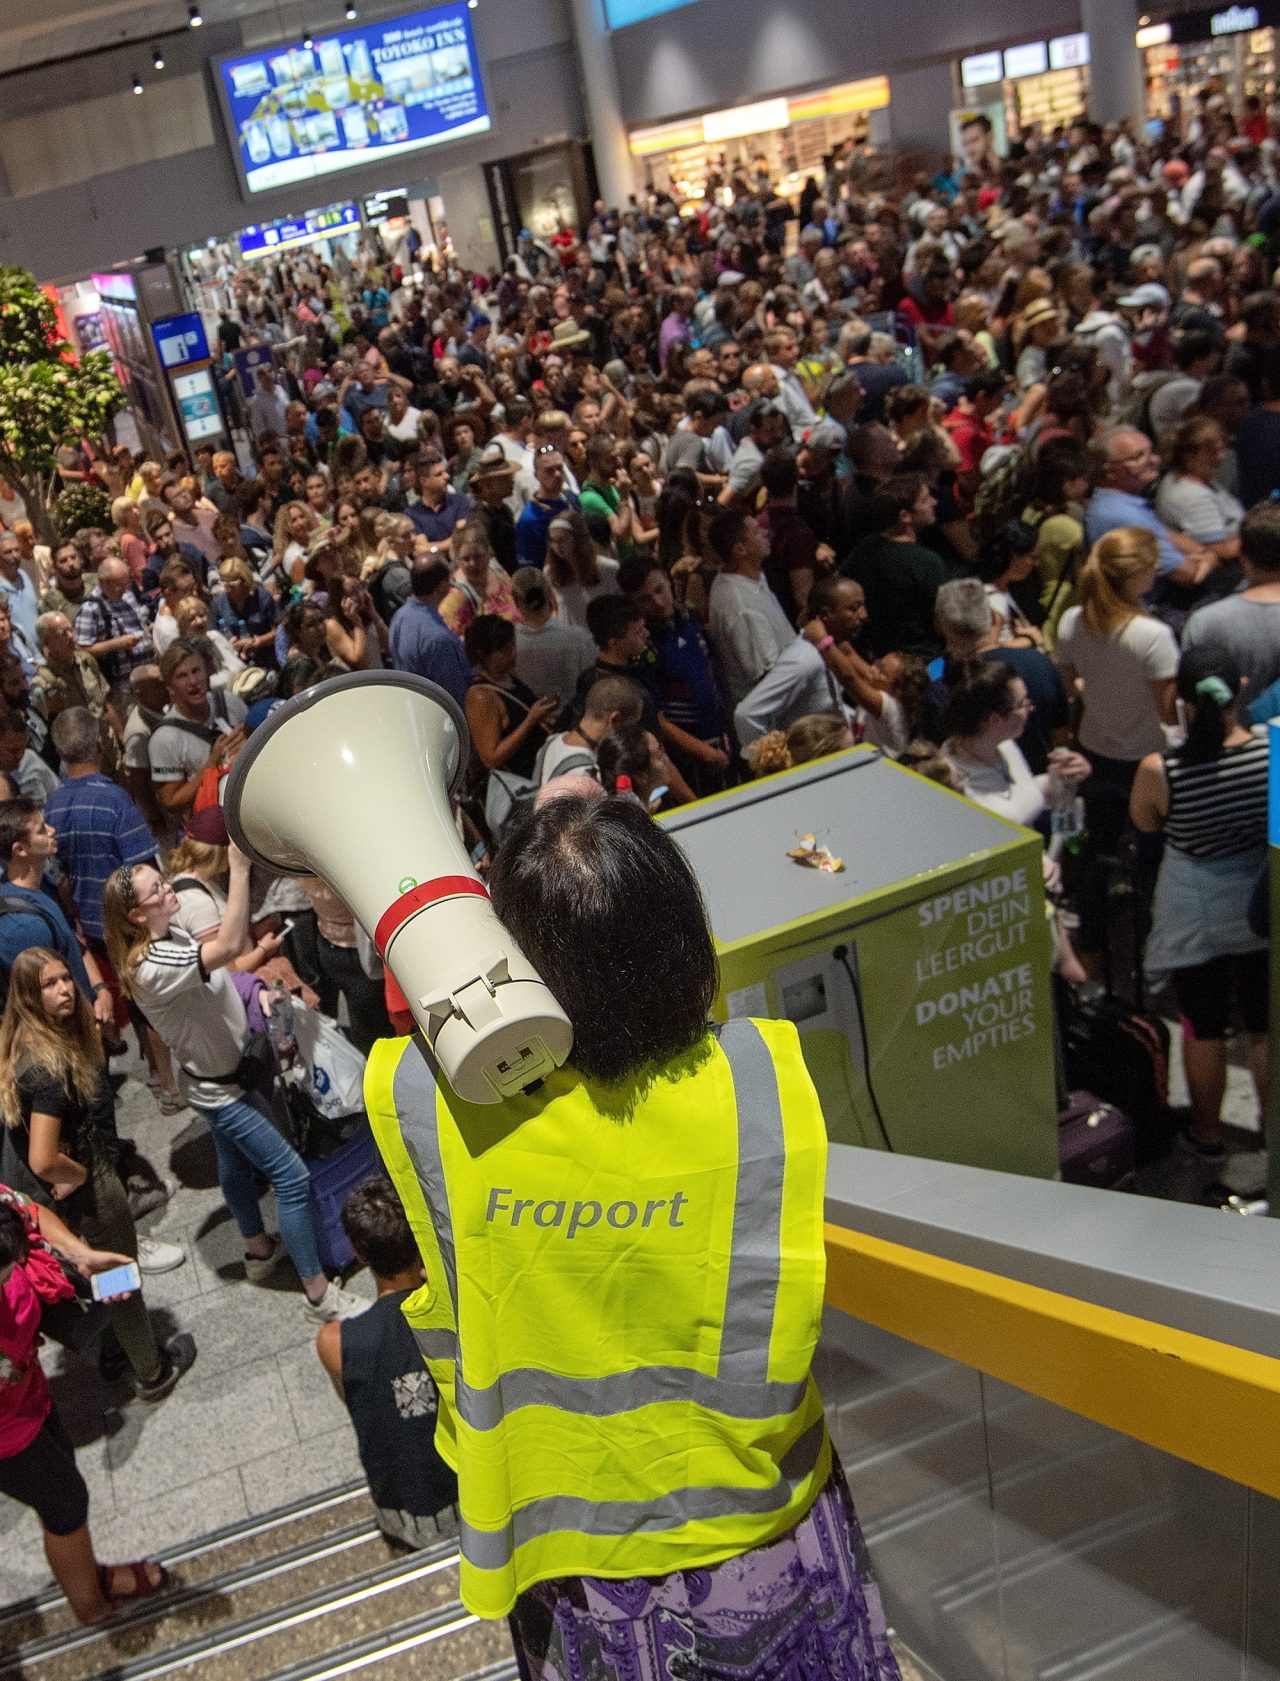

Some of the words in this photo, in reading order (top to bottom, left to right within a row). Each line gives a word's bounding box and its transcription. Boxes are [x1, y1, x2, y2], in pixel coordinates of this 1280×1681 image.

[917, 868, 1029, 928] SPENDE
[967, 895, 1030, 938] DEIN
[915, 922, 1028, 983] LEERGUT
[915, 963, 1034, 1026] DONATE
[962, 988, 1034, 1032] YOUR
[932, 1013, 1036, 1070] EMPTIES
[486, 1187, 689, 1239] Fraport
